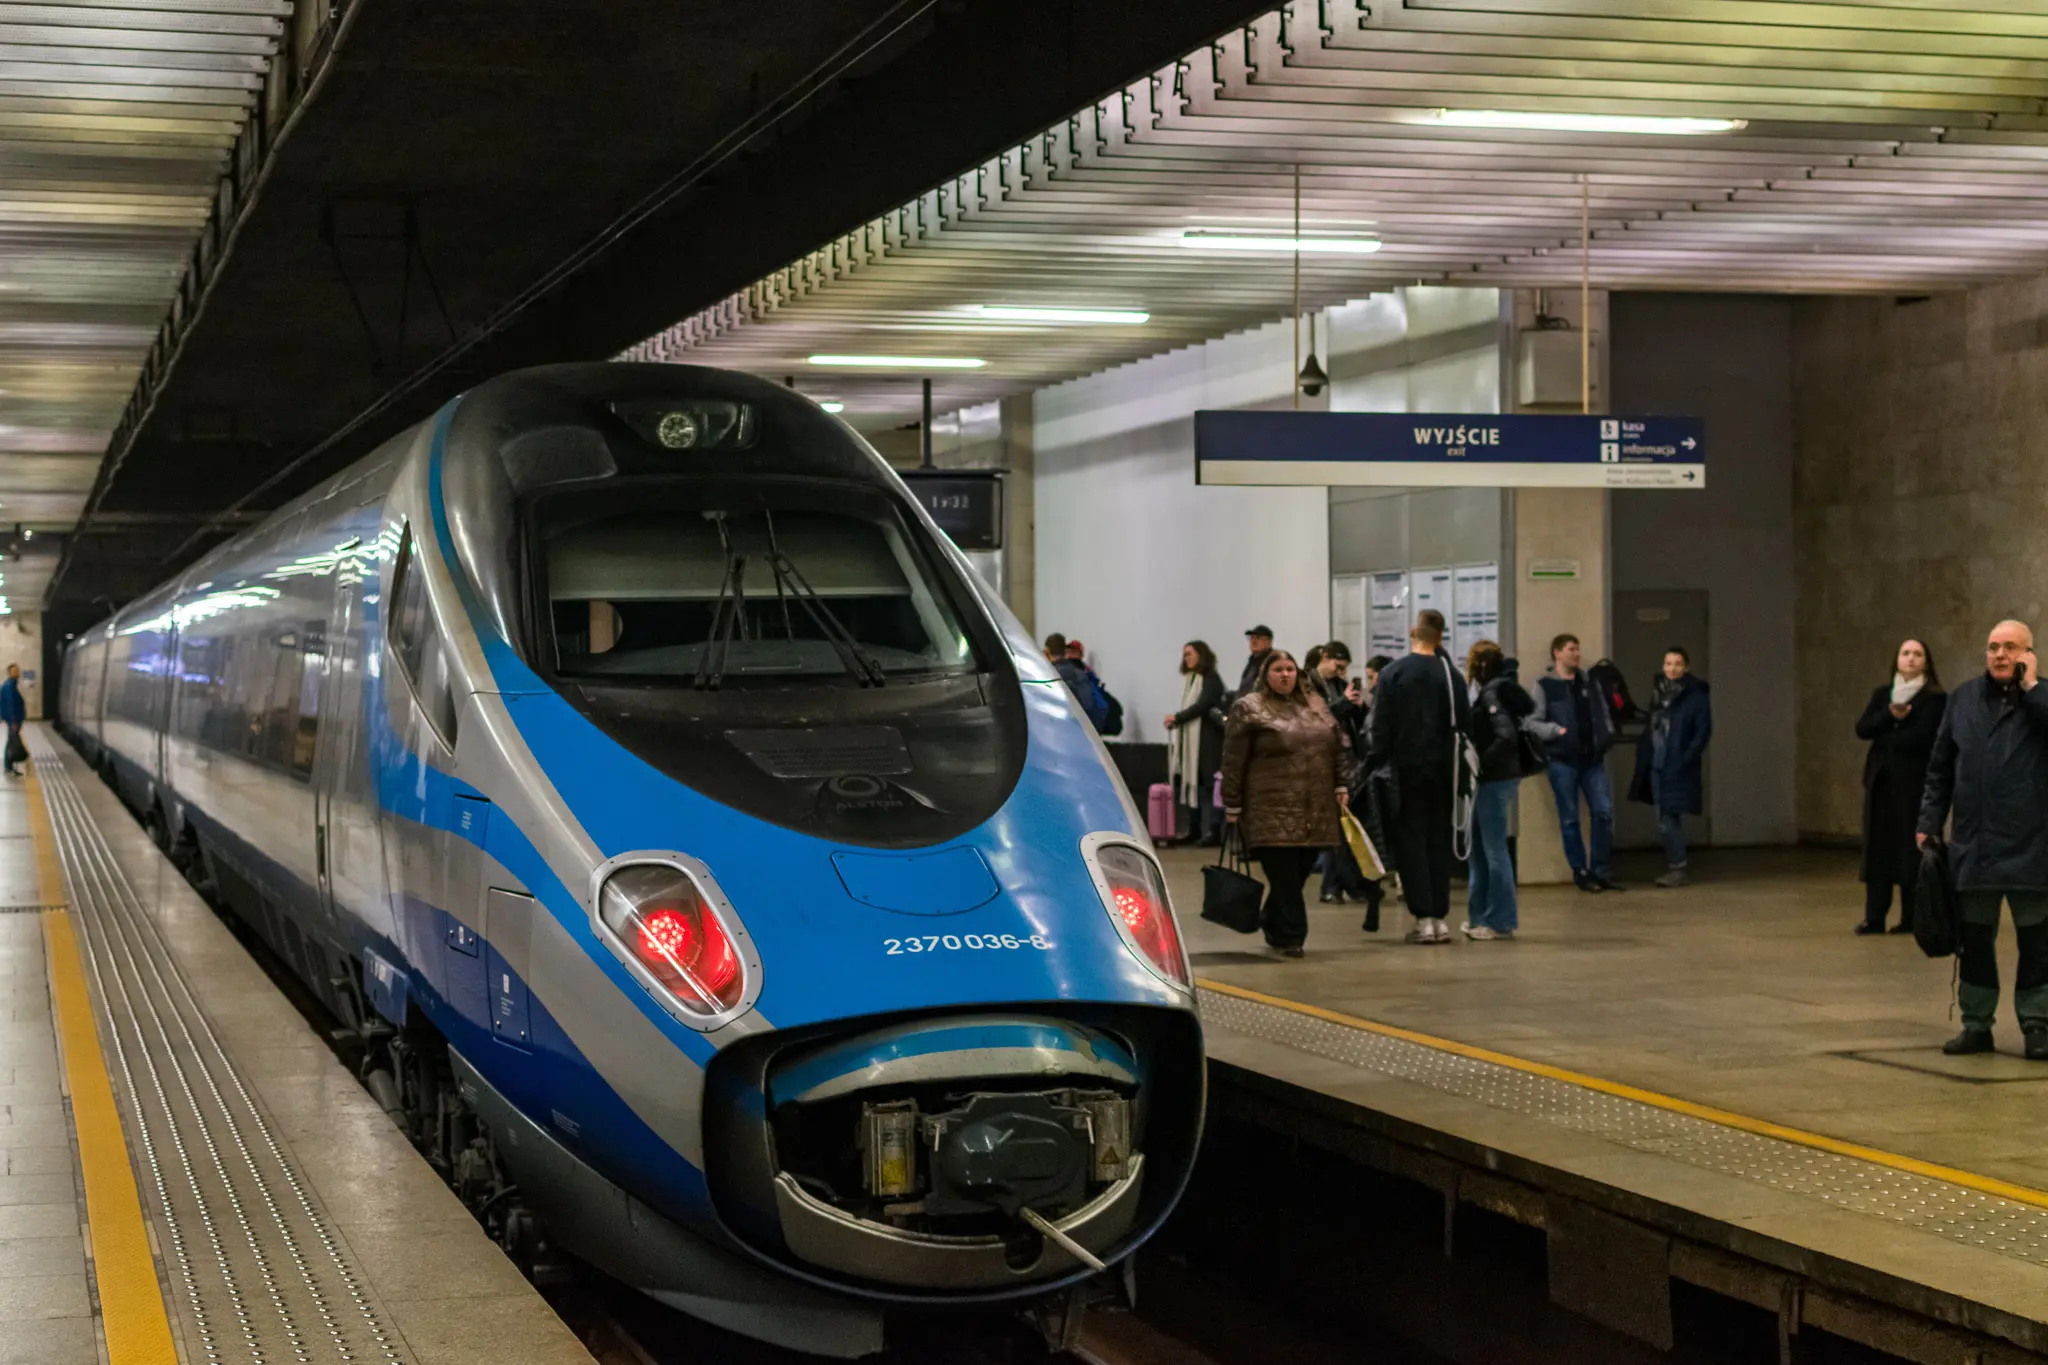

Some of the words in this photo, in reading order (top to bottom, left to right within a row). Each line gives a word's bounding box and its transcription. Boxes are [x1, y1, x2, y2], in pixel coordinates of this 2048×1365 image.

[1622, 420, 1645, 432] kasa
[1413, 425, 1500, 445] WYJŚCIE
[1447, 447, 1466, 457] exit
[883, 934, 1048, 955] 2370036-8
